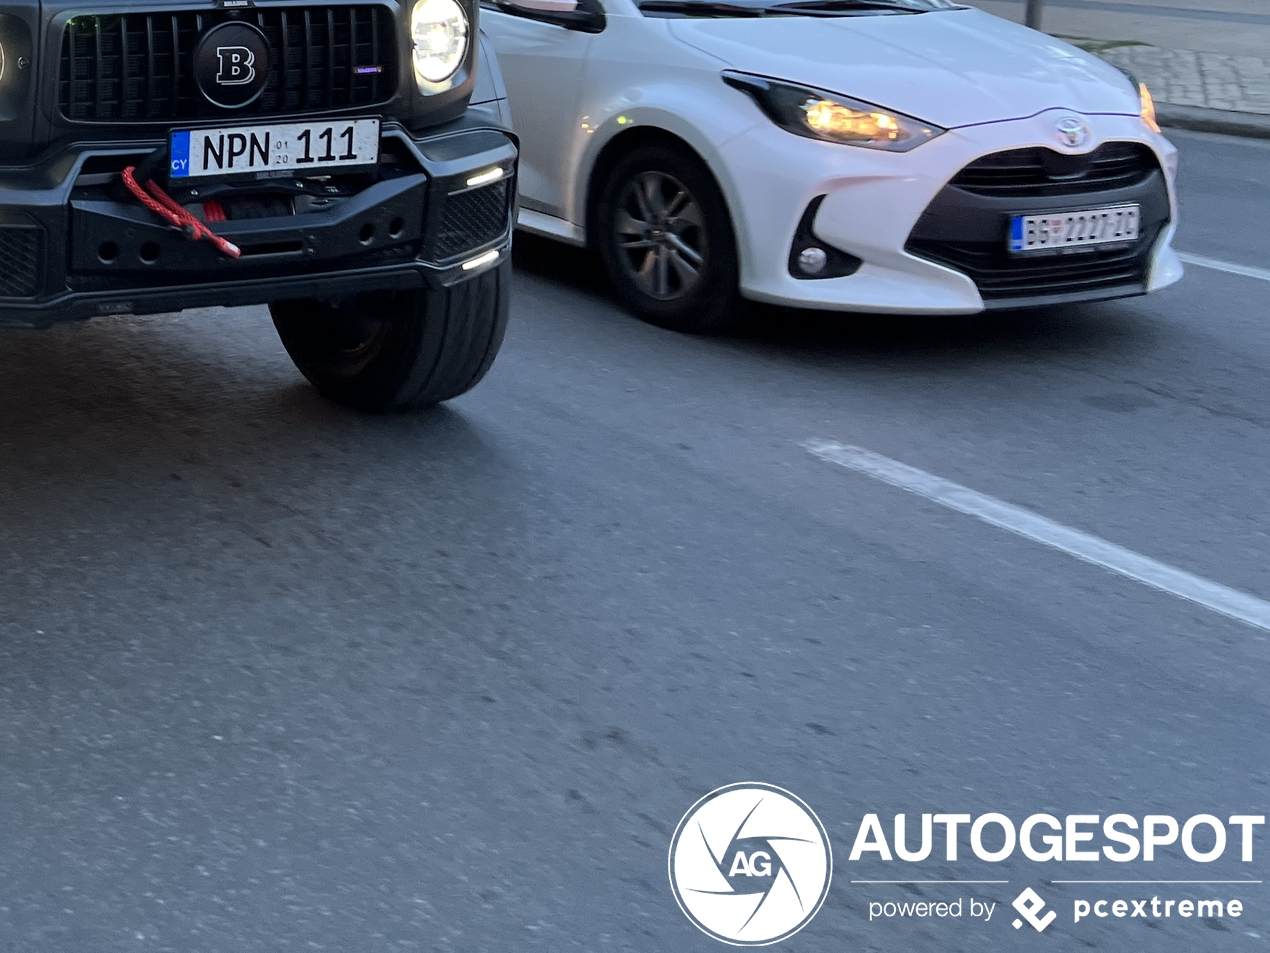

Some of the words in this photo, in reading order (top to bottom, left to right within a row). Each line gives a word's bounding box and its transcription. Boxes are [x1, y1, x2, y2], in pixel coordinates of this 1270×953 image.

[215, 45, 256, 86] B
[202, 131, 270, 170] NPN
[296, 126, 358, 164] 111
[275, 140, 288, 149] 01
[171, 158, 188, 171] CY
[276, 155, 289, 164] 20
